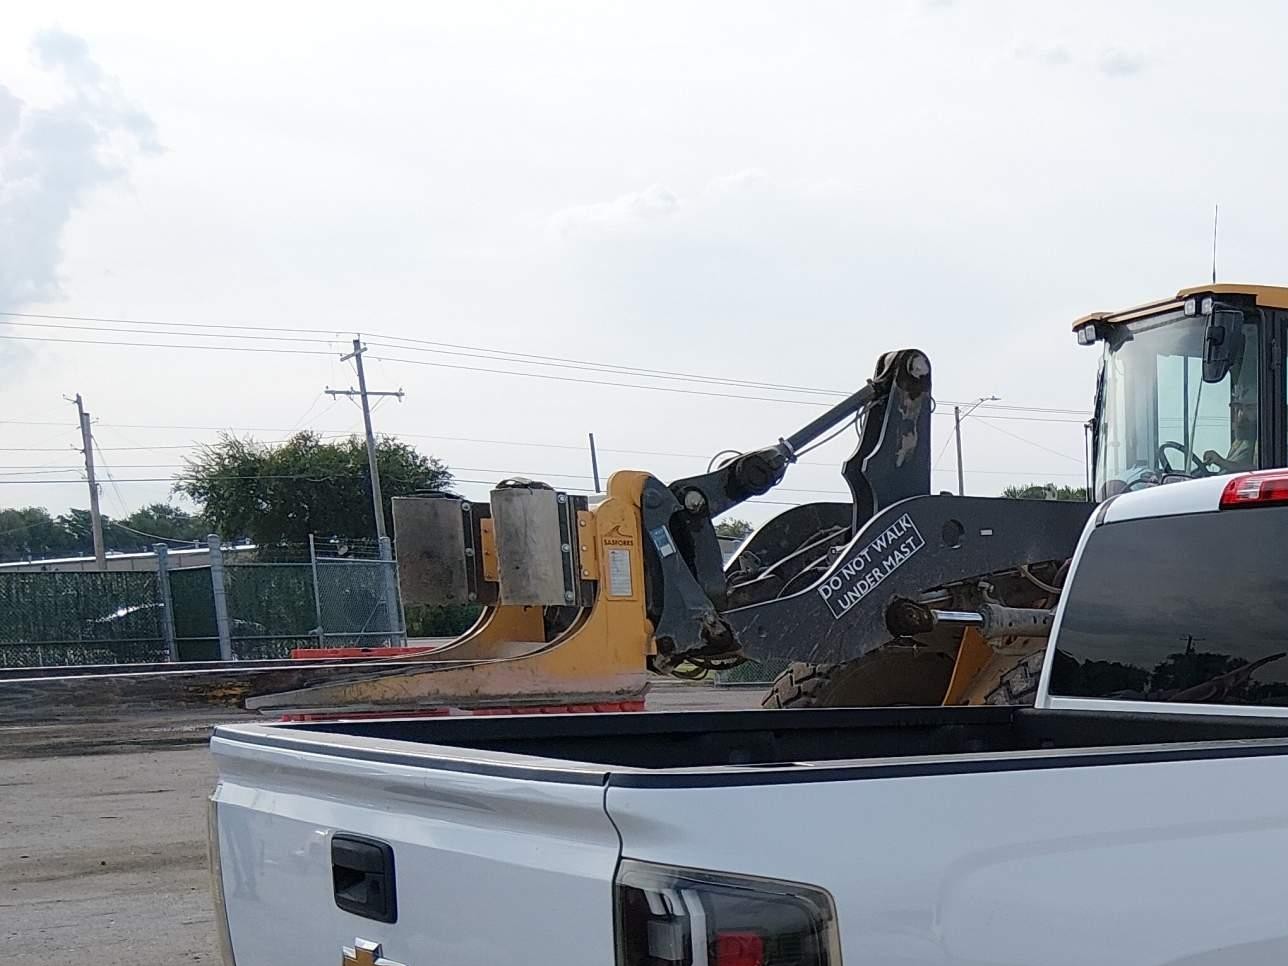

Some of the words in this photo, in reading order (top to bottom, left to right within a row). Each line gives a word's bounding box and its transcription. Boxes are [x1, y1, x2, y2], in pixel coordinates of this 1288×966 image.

[820, 576, 842, 600] DO
[842, 549, 872, 580] NOT
[871, 516, 912, 552] WALK
[838, 567, 884, 609] UNDER
[882, 536, 916, 573] MAST
